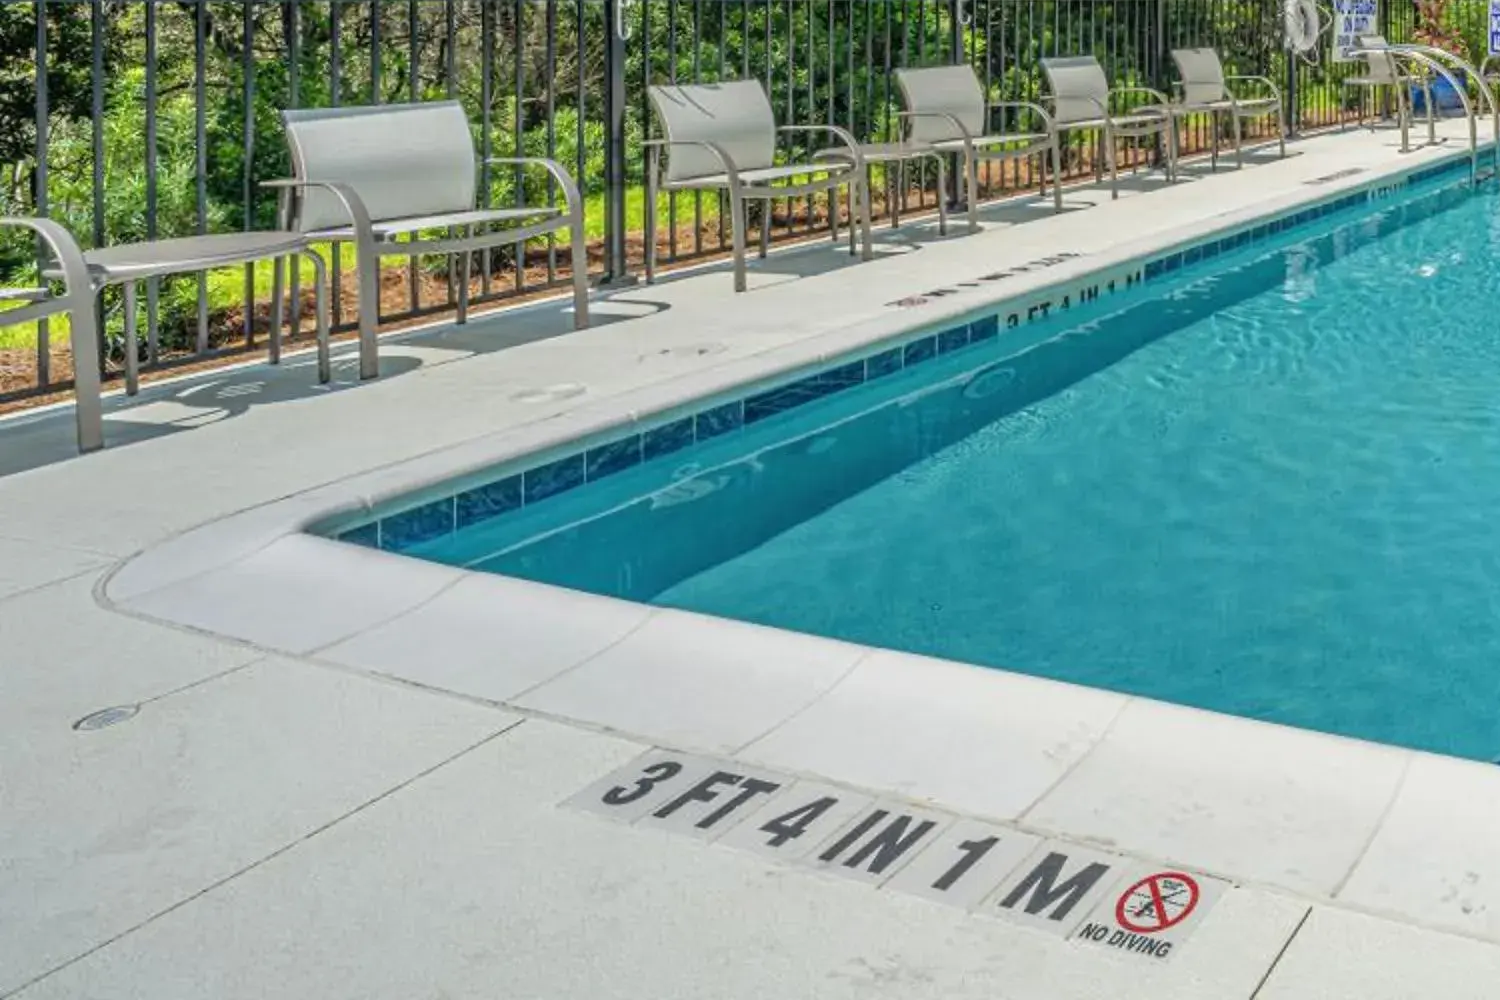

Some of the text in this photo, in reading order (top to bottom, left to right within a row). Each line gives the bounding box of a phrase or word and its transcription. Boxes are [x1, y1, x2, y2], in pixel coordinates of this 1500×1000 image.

[602, 761, 1110, 921] 3 FT 4 IN 1 M
[1079, 922, 1173, 958] NO DIVING
